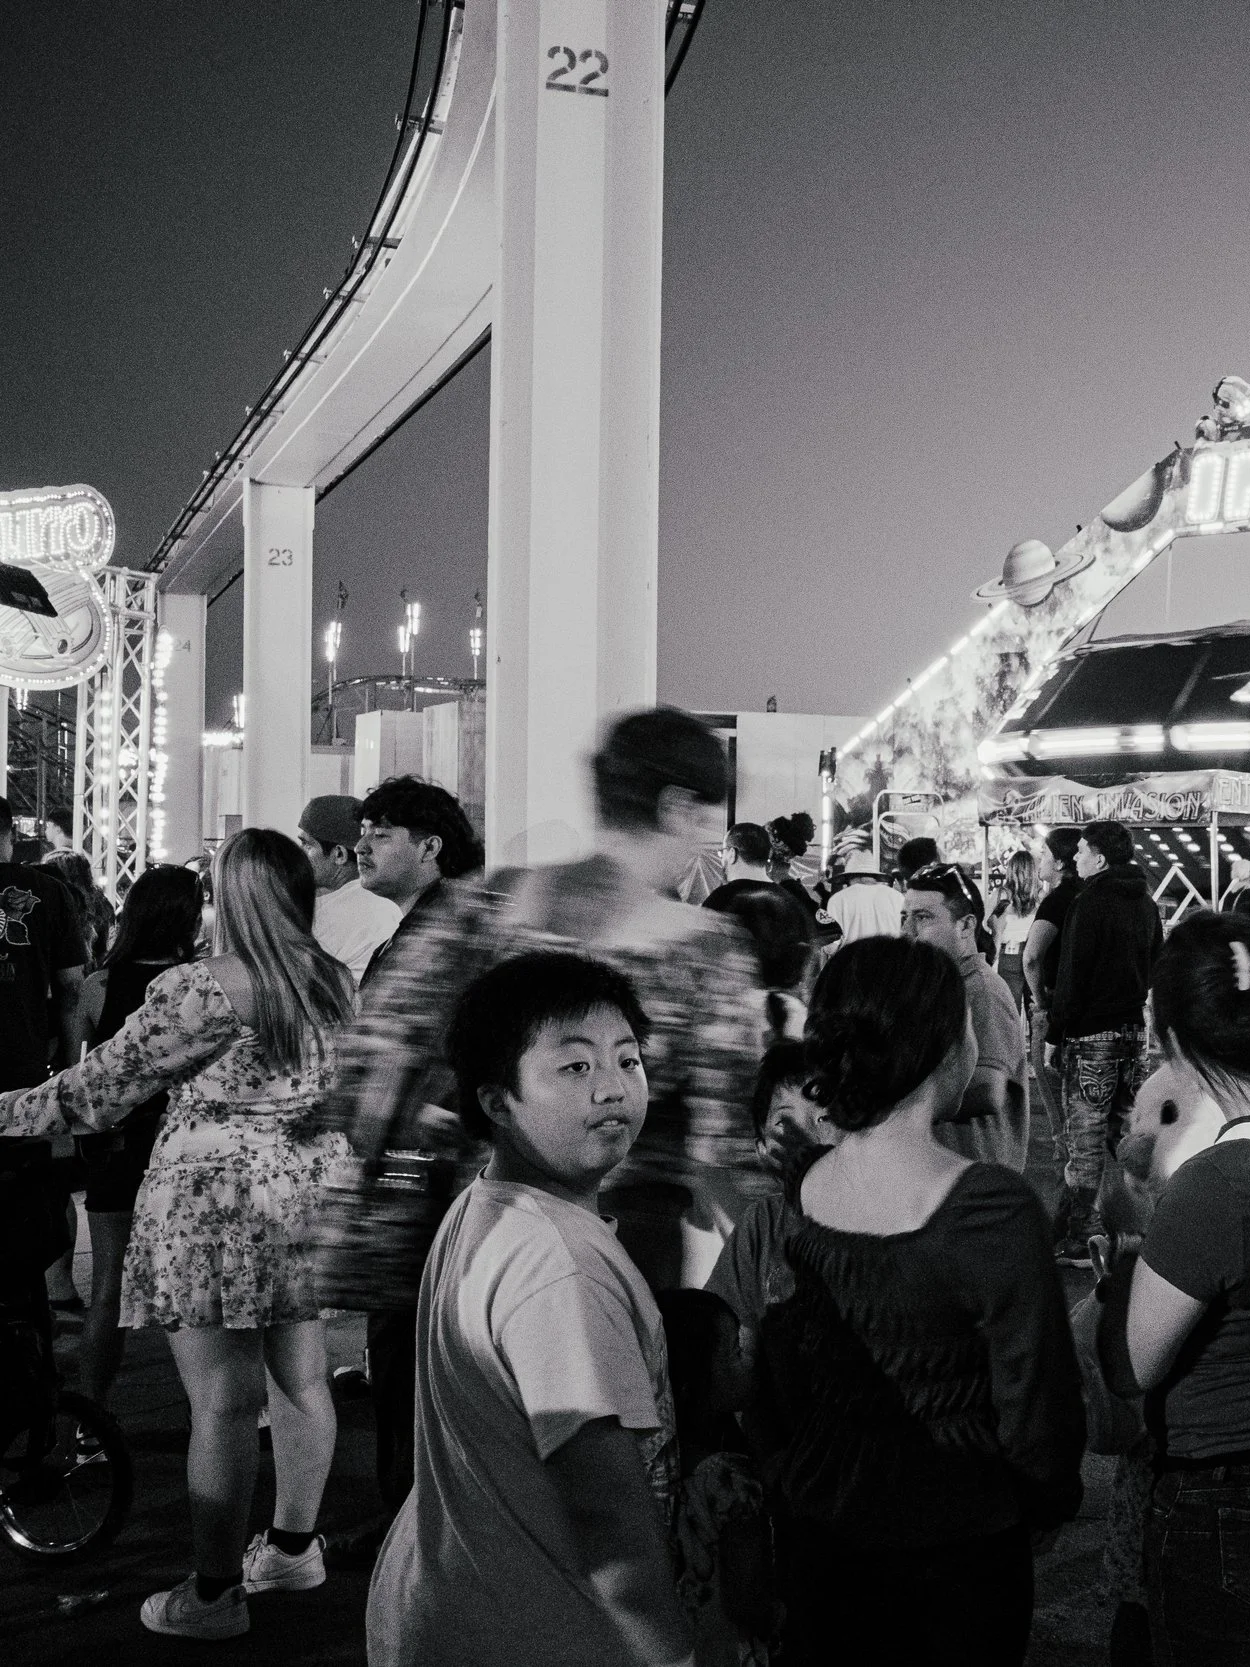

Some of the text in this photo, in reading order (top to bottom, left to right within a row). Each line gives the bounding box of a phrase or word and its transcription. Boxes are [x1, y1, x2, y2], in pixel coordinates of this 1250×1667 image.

[546, 45, 609, 97] 22
[268, 548, 293, 566] 23
[1023, 789, 1204, 823] ALIEN INVASION
